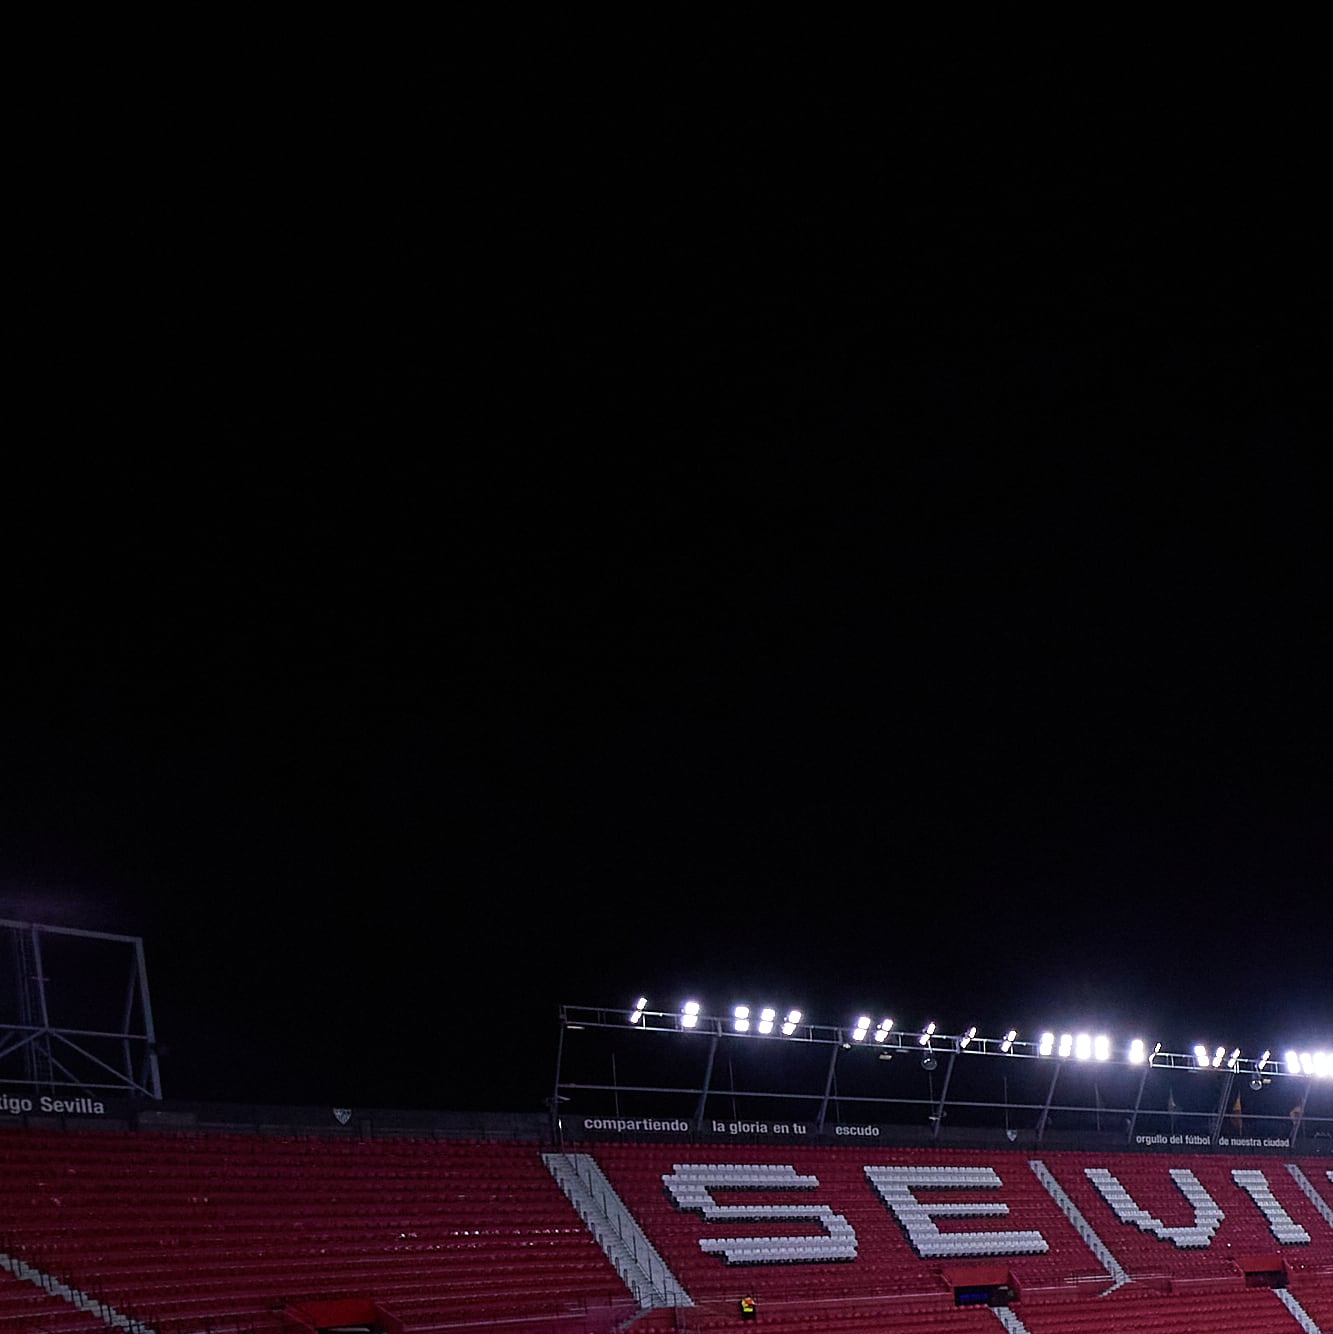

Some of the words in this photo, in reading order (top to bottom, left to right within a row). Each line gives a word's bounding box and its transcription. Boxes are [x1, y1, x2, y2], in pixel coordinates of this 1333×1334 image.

[40, 1096, 105, 1114] Sevilla
[584, 1118, 689, 1132] compartiendo
[712, 1120, 726, 1132] la
[729, 1121, 768, 1135] gloria
[773, 1123, 790, 1134] en
[793, 1122, 807, 1134] tu
[835, 1124, 880, 1136] escudo
[1136, 1134, 1168, 1146] orgullo
[1169, 1135, 1183, 1144] del
[1185, 1134, 1211, 1145] fútbol
[1218, 1136, 1229, 1146] de
[1231, 1138, 1262, 1147] nuestra
[1263, 1137, 1290, 1147] ciudad
